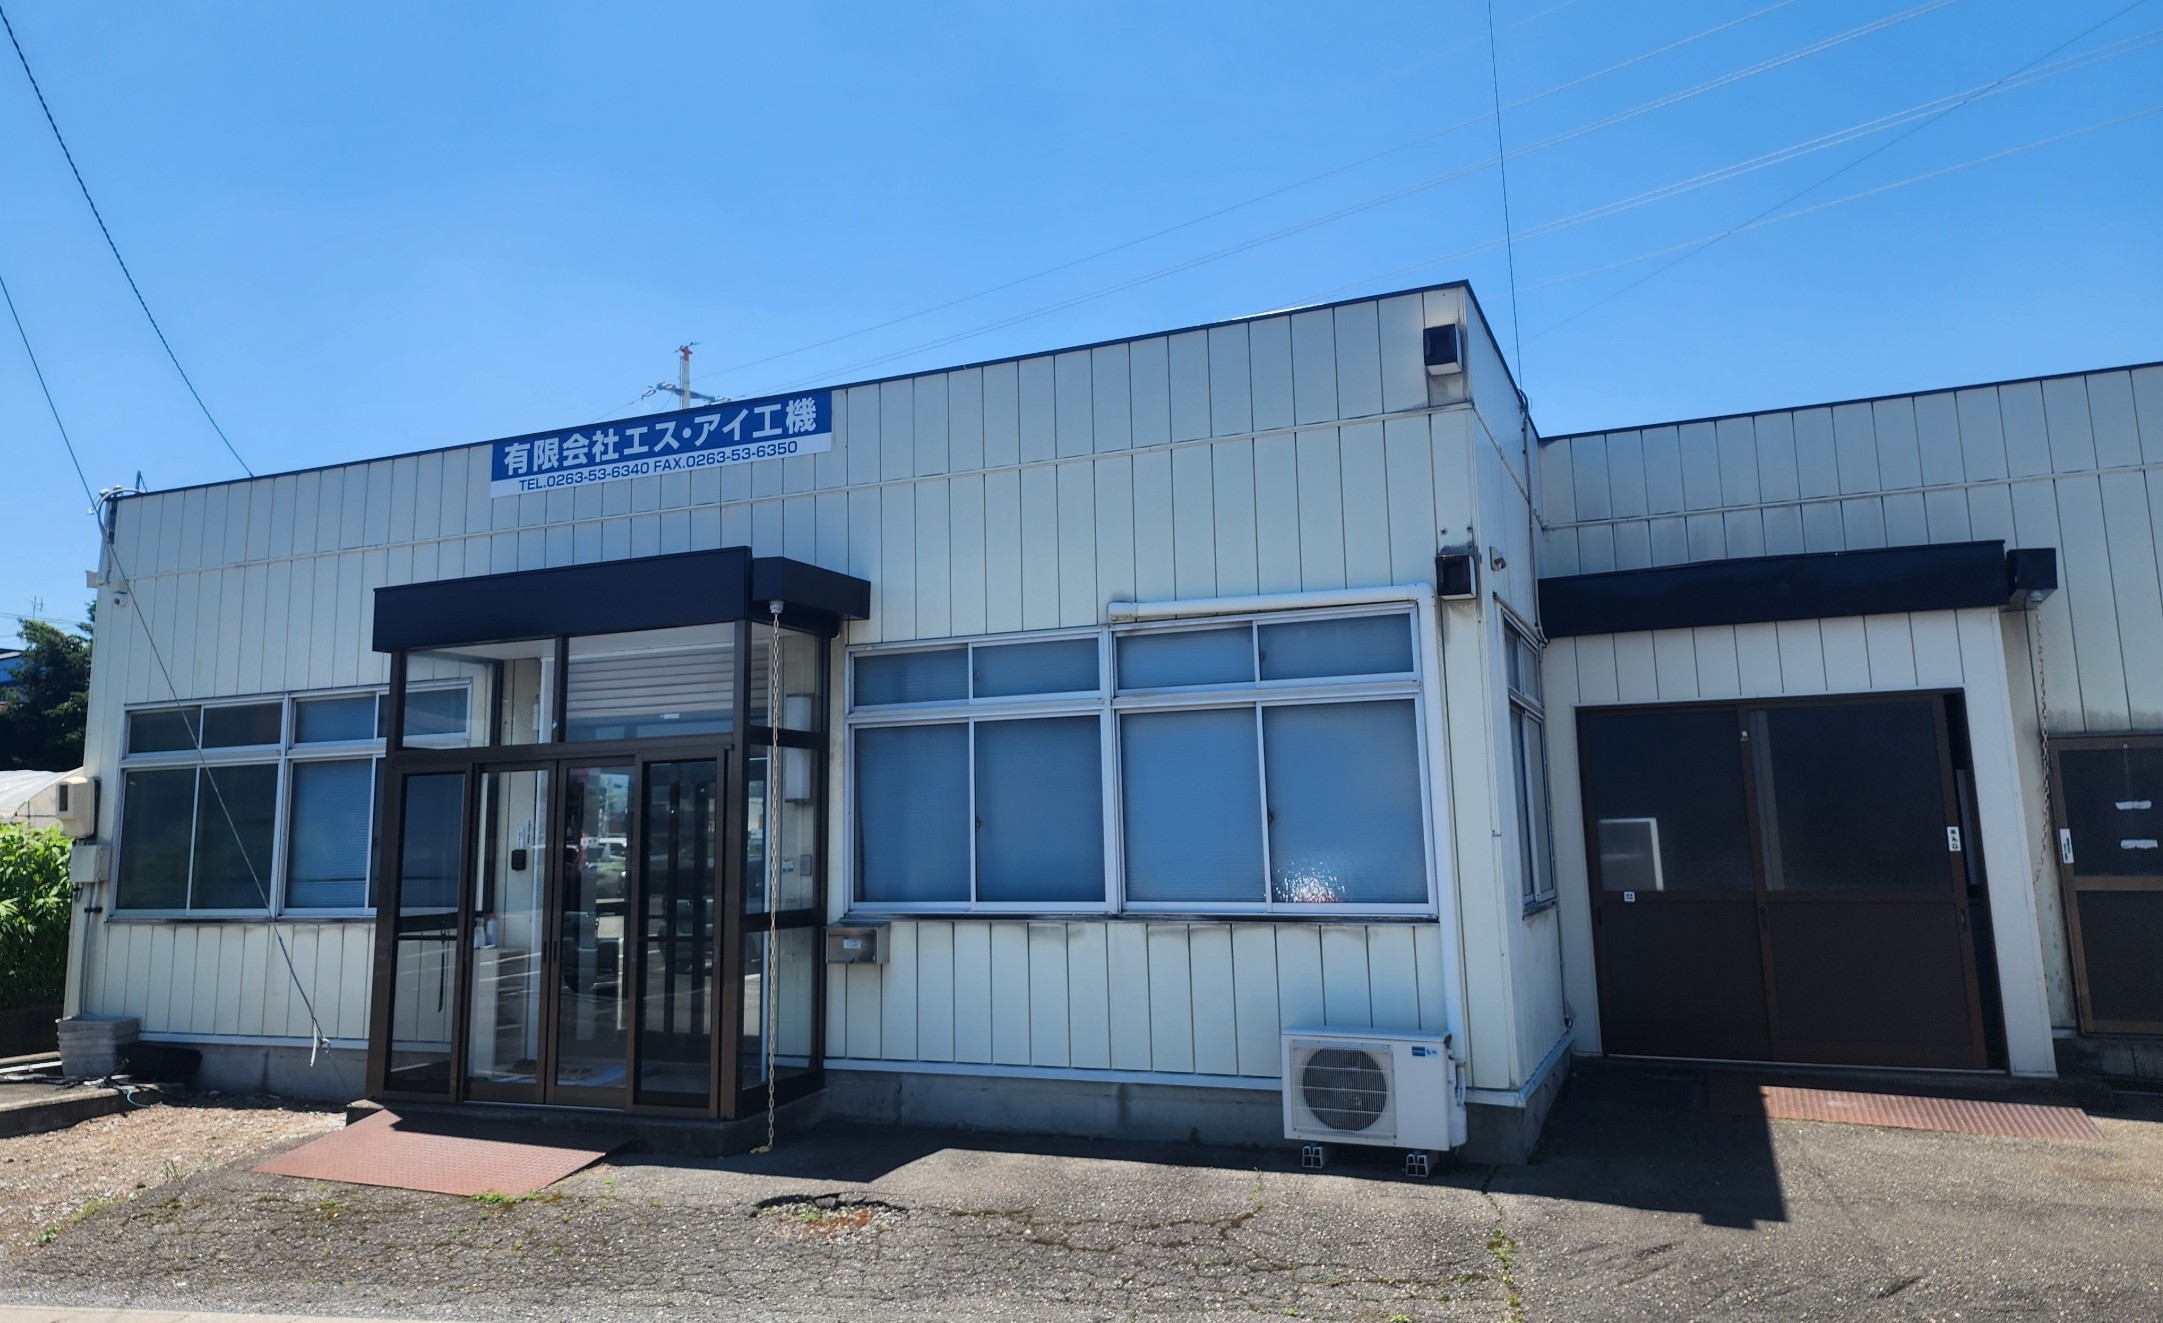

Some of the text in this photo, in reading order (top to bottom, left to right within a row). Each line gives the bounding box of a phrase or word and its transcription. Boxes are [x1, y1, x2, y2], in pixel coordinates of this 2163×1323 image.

[504, 397, 817, 476] 有限会社エス・アイ工機
[519, 440, 798, 491] TEL.0263-53-6340 FAX.0263-53-6350
